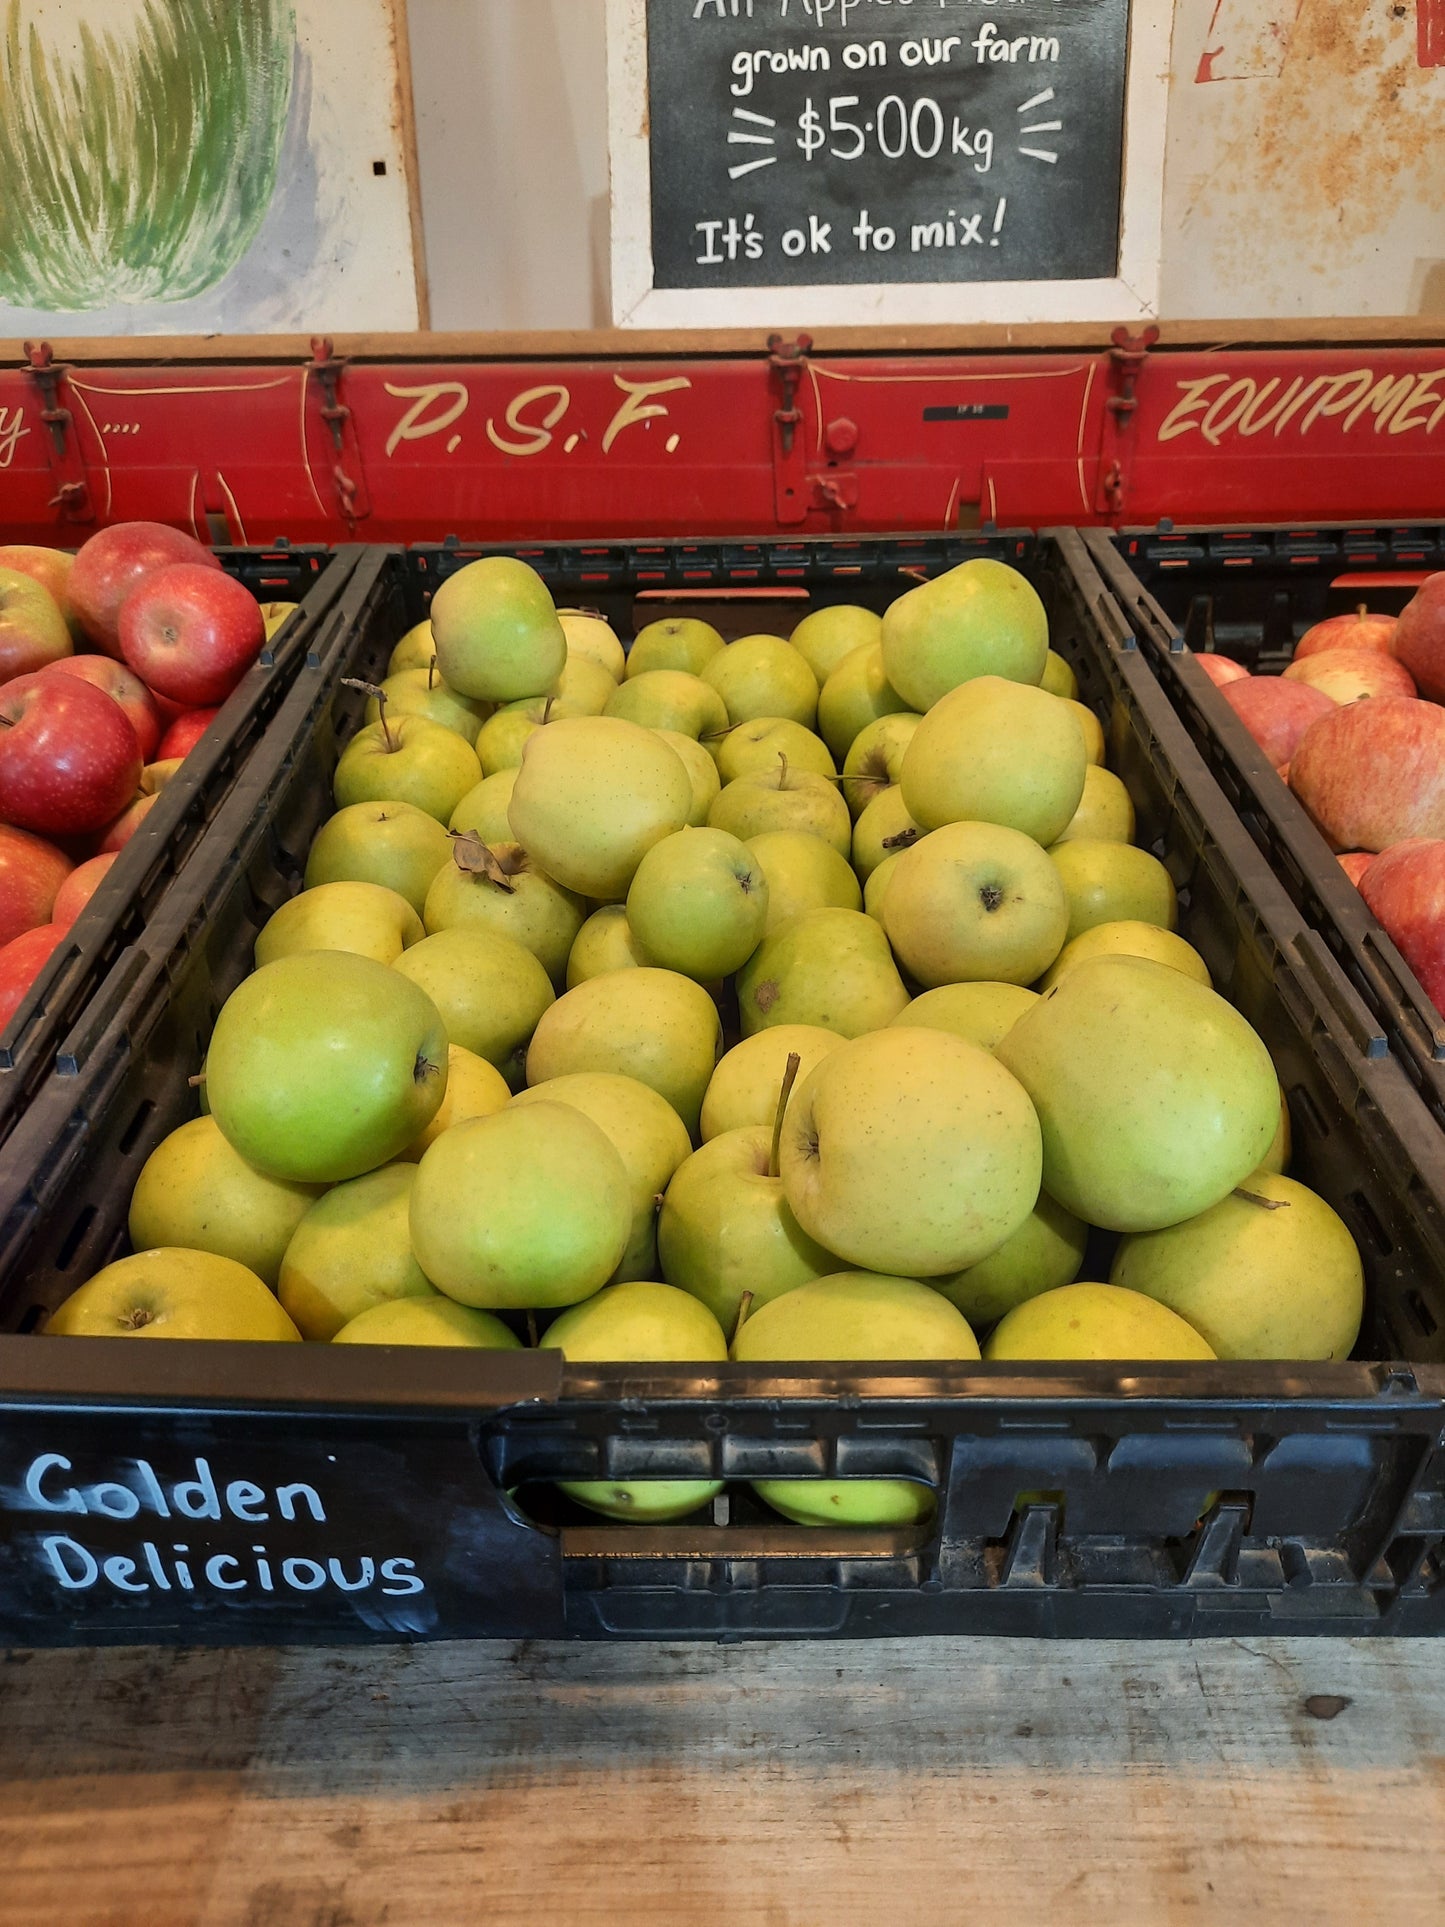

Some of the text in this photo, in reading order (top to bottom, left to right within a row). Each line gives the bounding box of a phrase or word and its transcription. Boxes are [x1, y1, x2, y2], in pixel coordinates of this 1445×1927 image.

[731, 23, 1061, 96] grown on our farm
[952, 116, 994, 173] kg
[695, 198, 1006, 264] It's ok to mix!
[26, 1453, 327, 1521] Golden
[42, 1536, 425, 1595] Delicious
